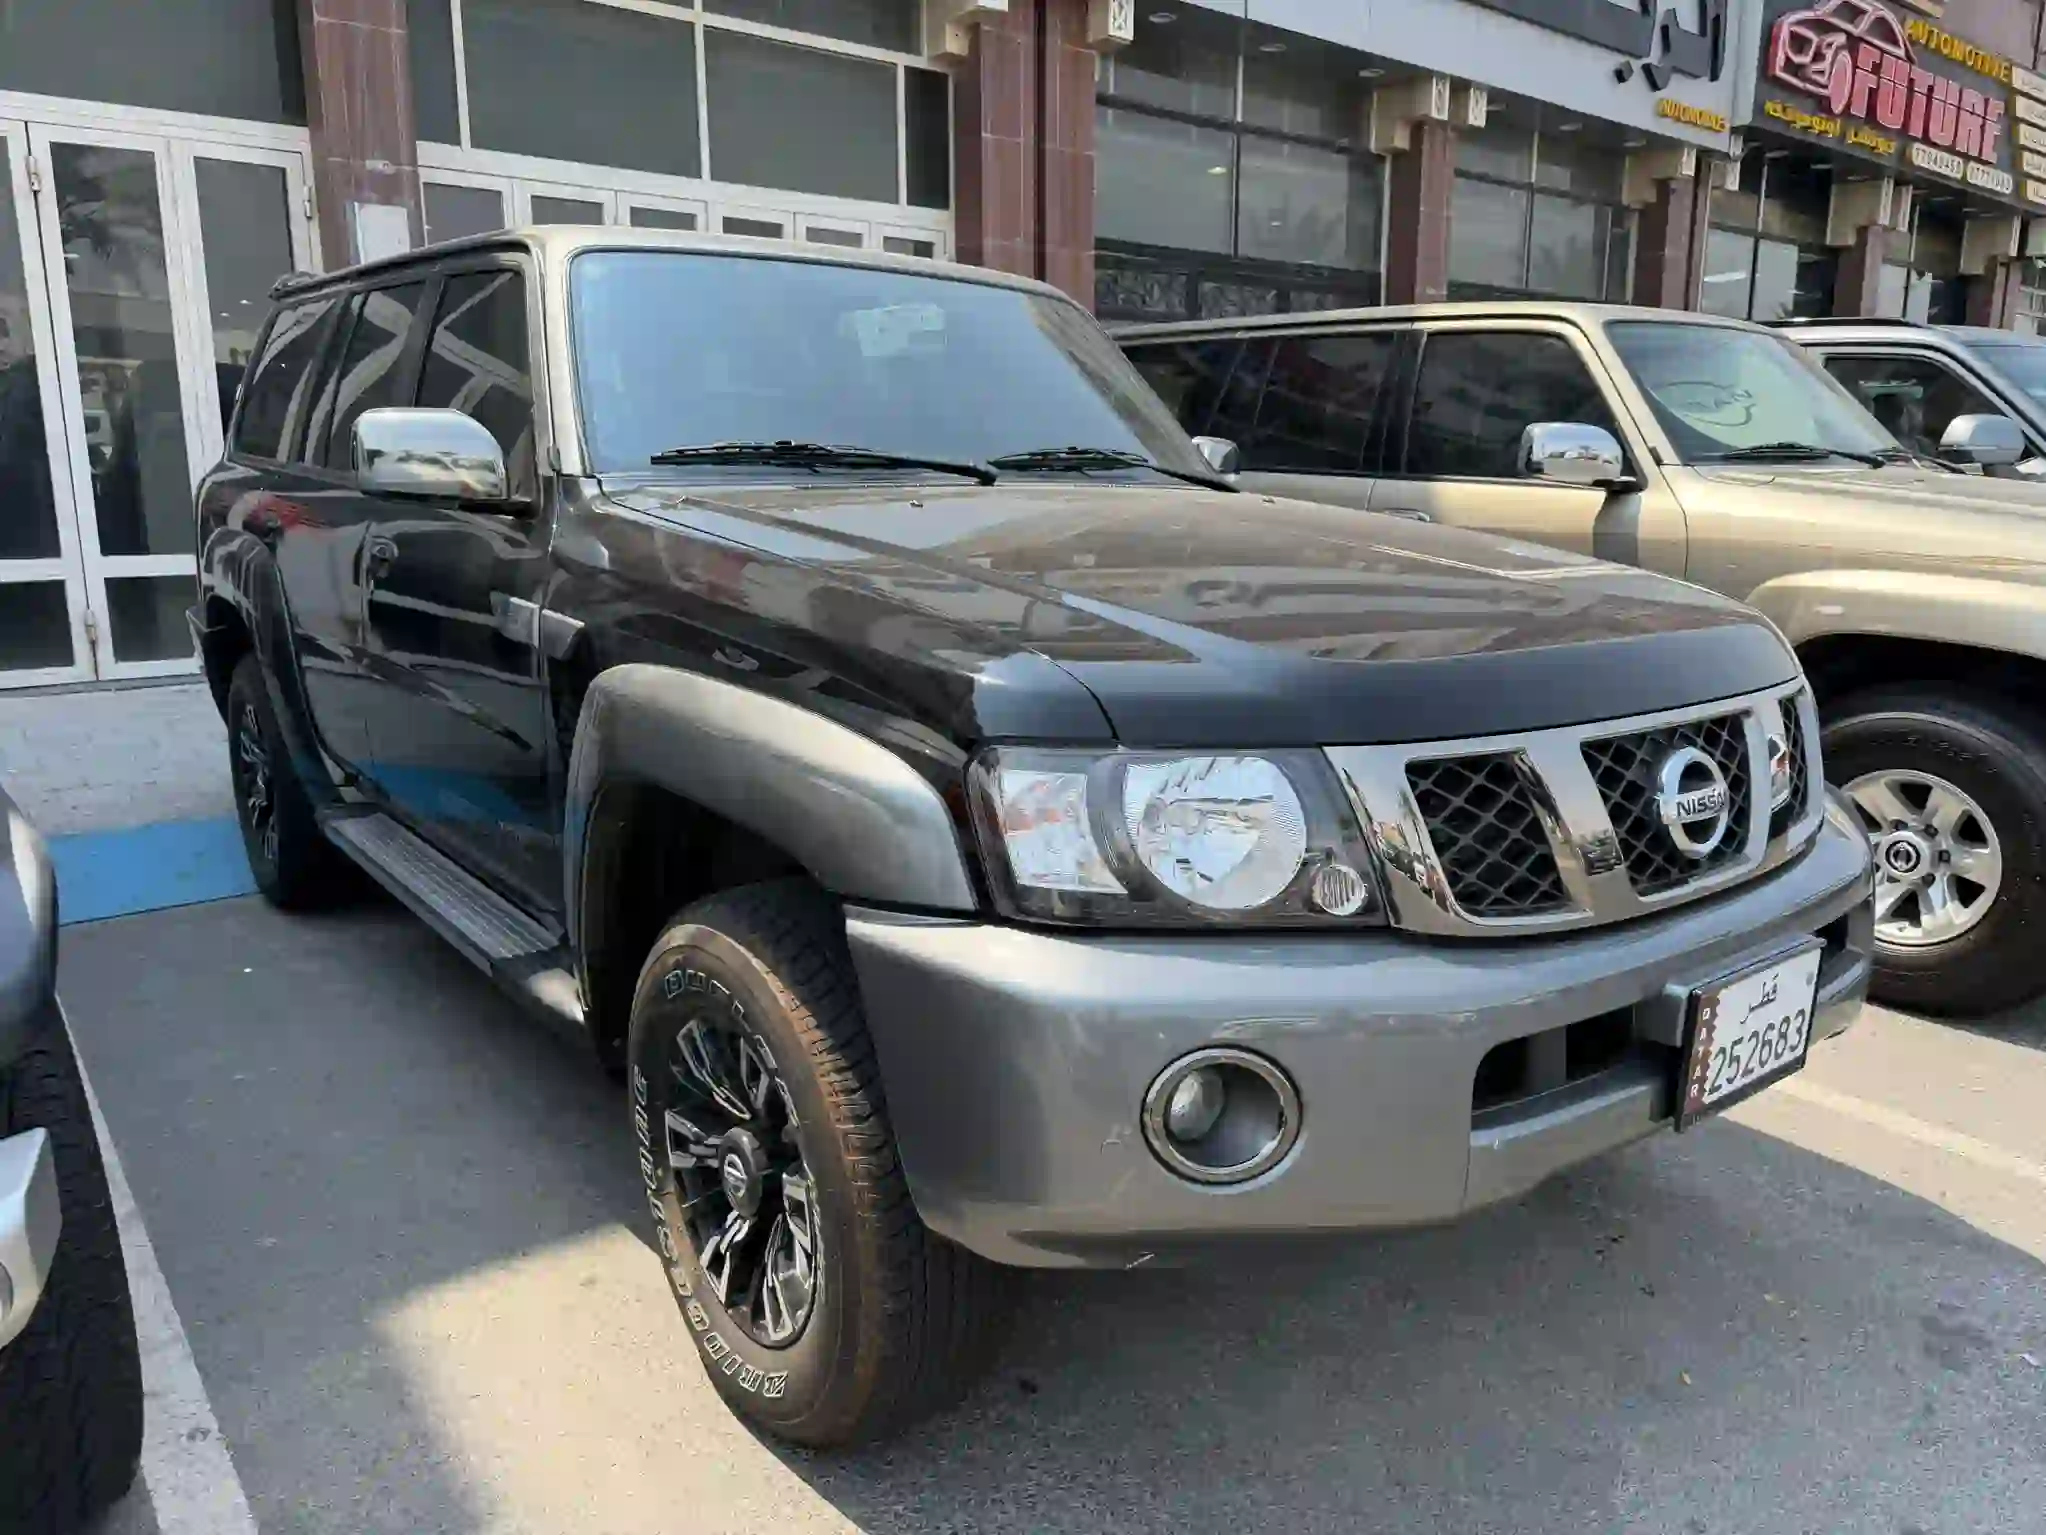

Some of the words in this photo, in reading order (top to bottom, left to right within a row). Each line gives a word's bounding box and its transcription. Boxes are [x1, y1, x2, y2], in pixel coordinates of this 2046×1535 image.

[1850, 42, 2006, 165] FUTURE
[1739, 972, 1780, 1025] قطر
[1706, 1008, 1806, 1096] 252683
